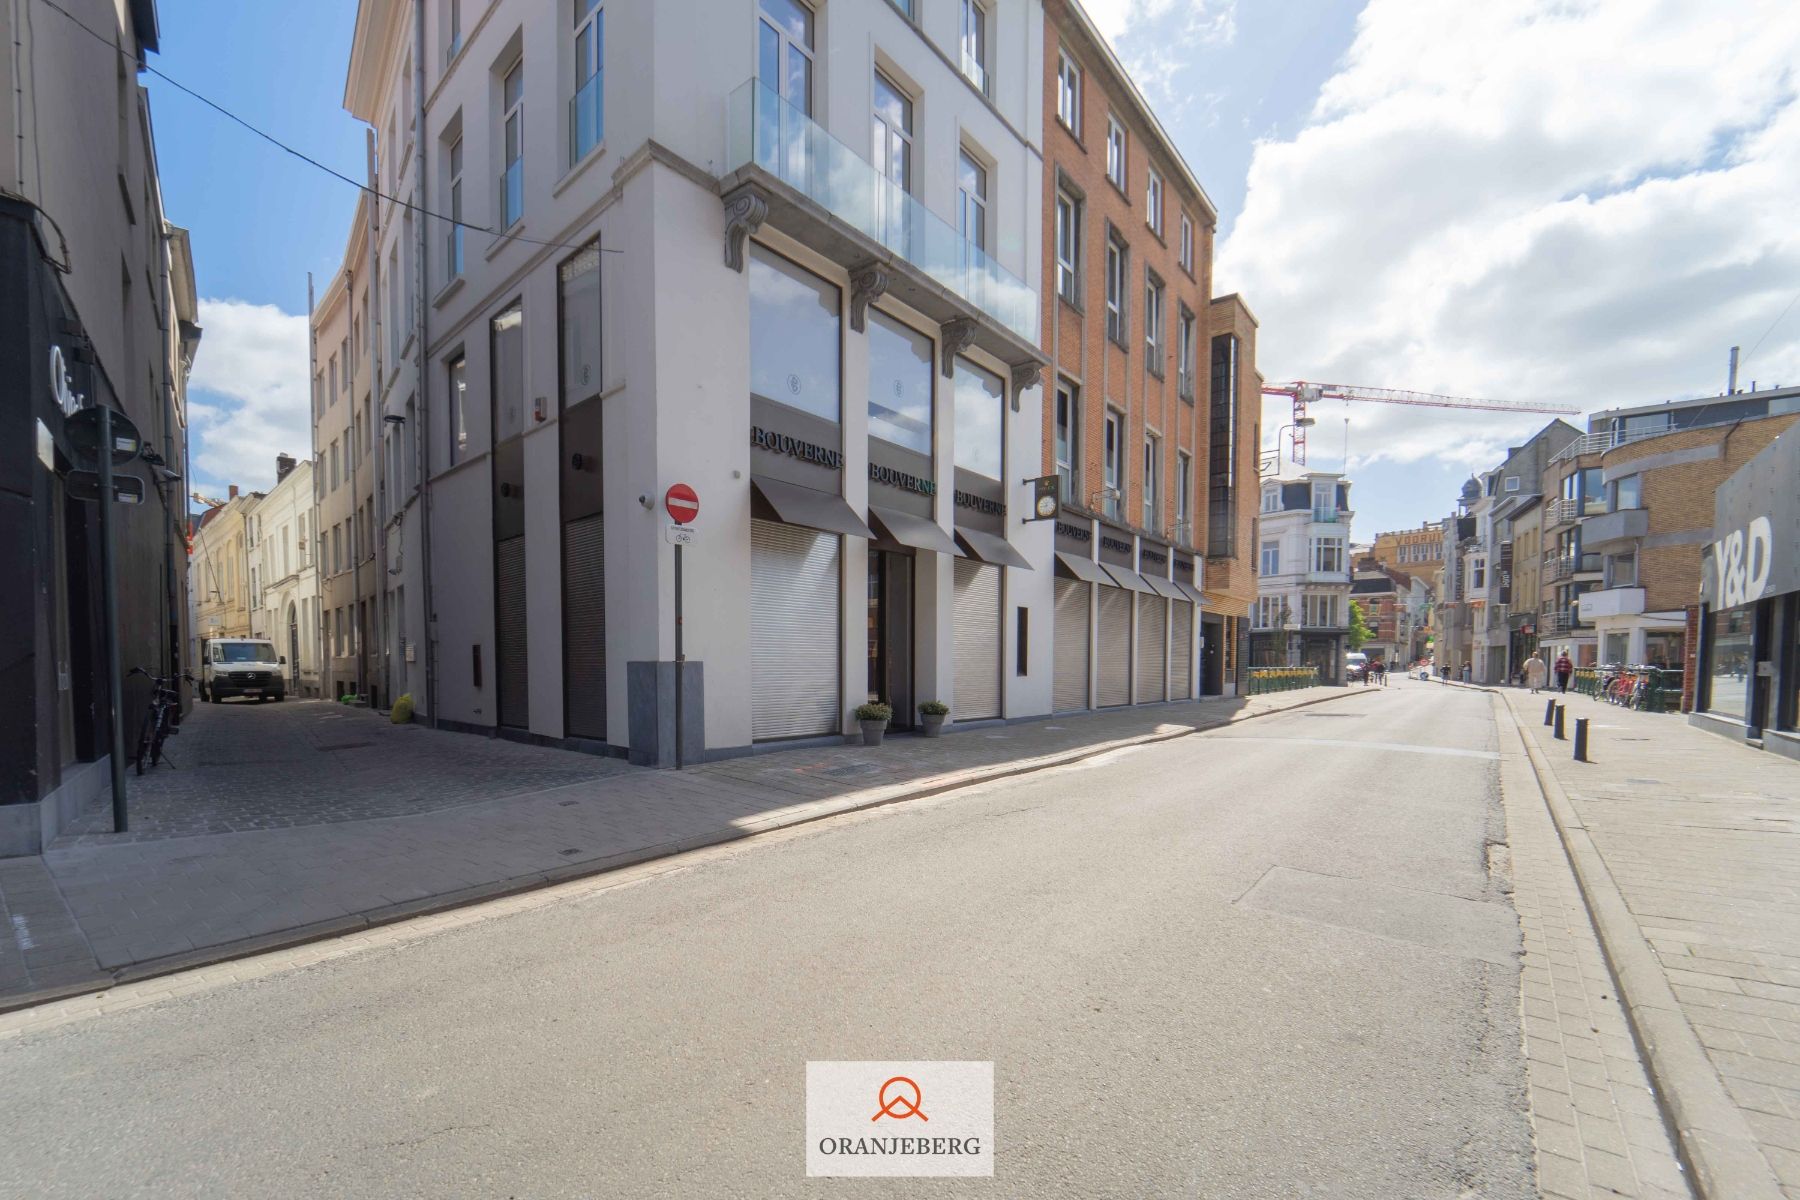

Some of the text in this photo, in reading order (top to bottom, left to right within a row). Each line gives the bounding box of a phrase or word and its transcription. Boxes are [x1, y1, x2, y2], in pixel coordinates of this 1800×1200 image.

[752, 426, 844, 470] BOUVERNE
[868, 462, 936, 496] BOUVERNE
[954, 489, 1007, 516] BOUVERNE
[1714, 516, 1772, 610] Y&D
